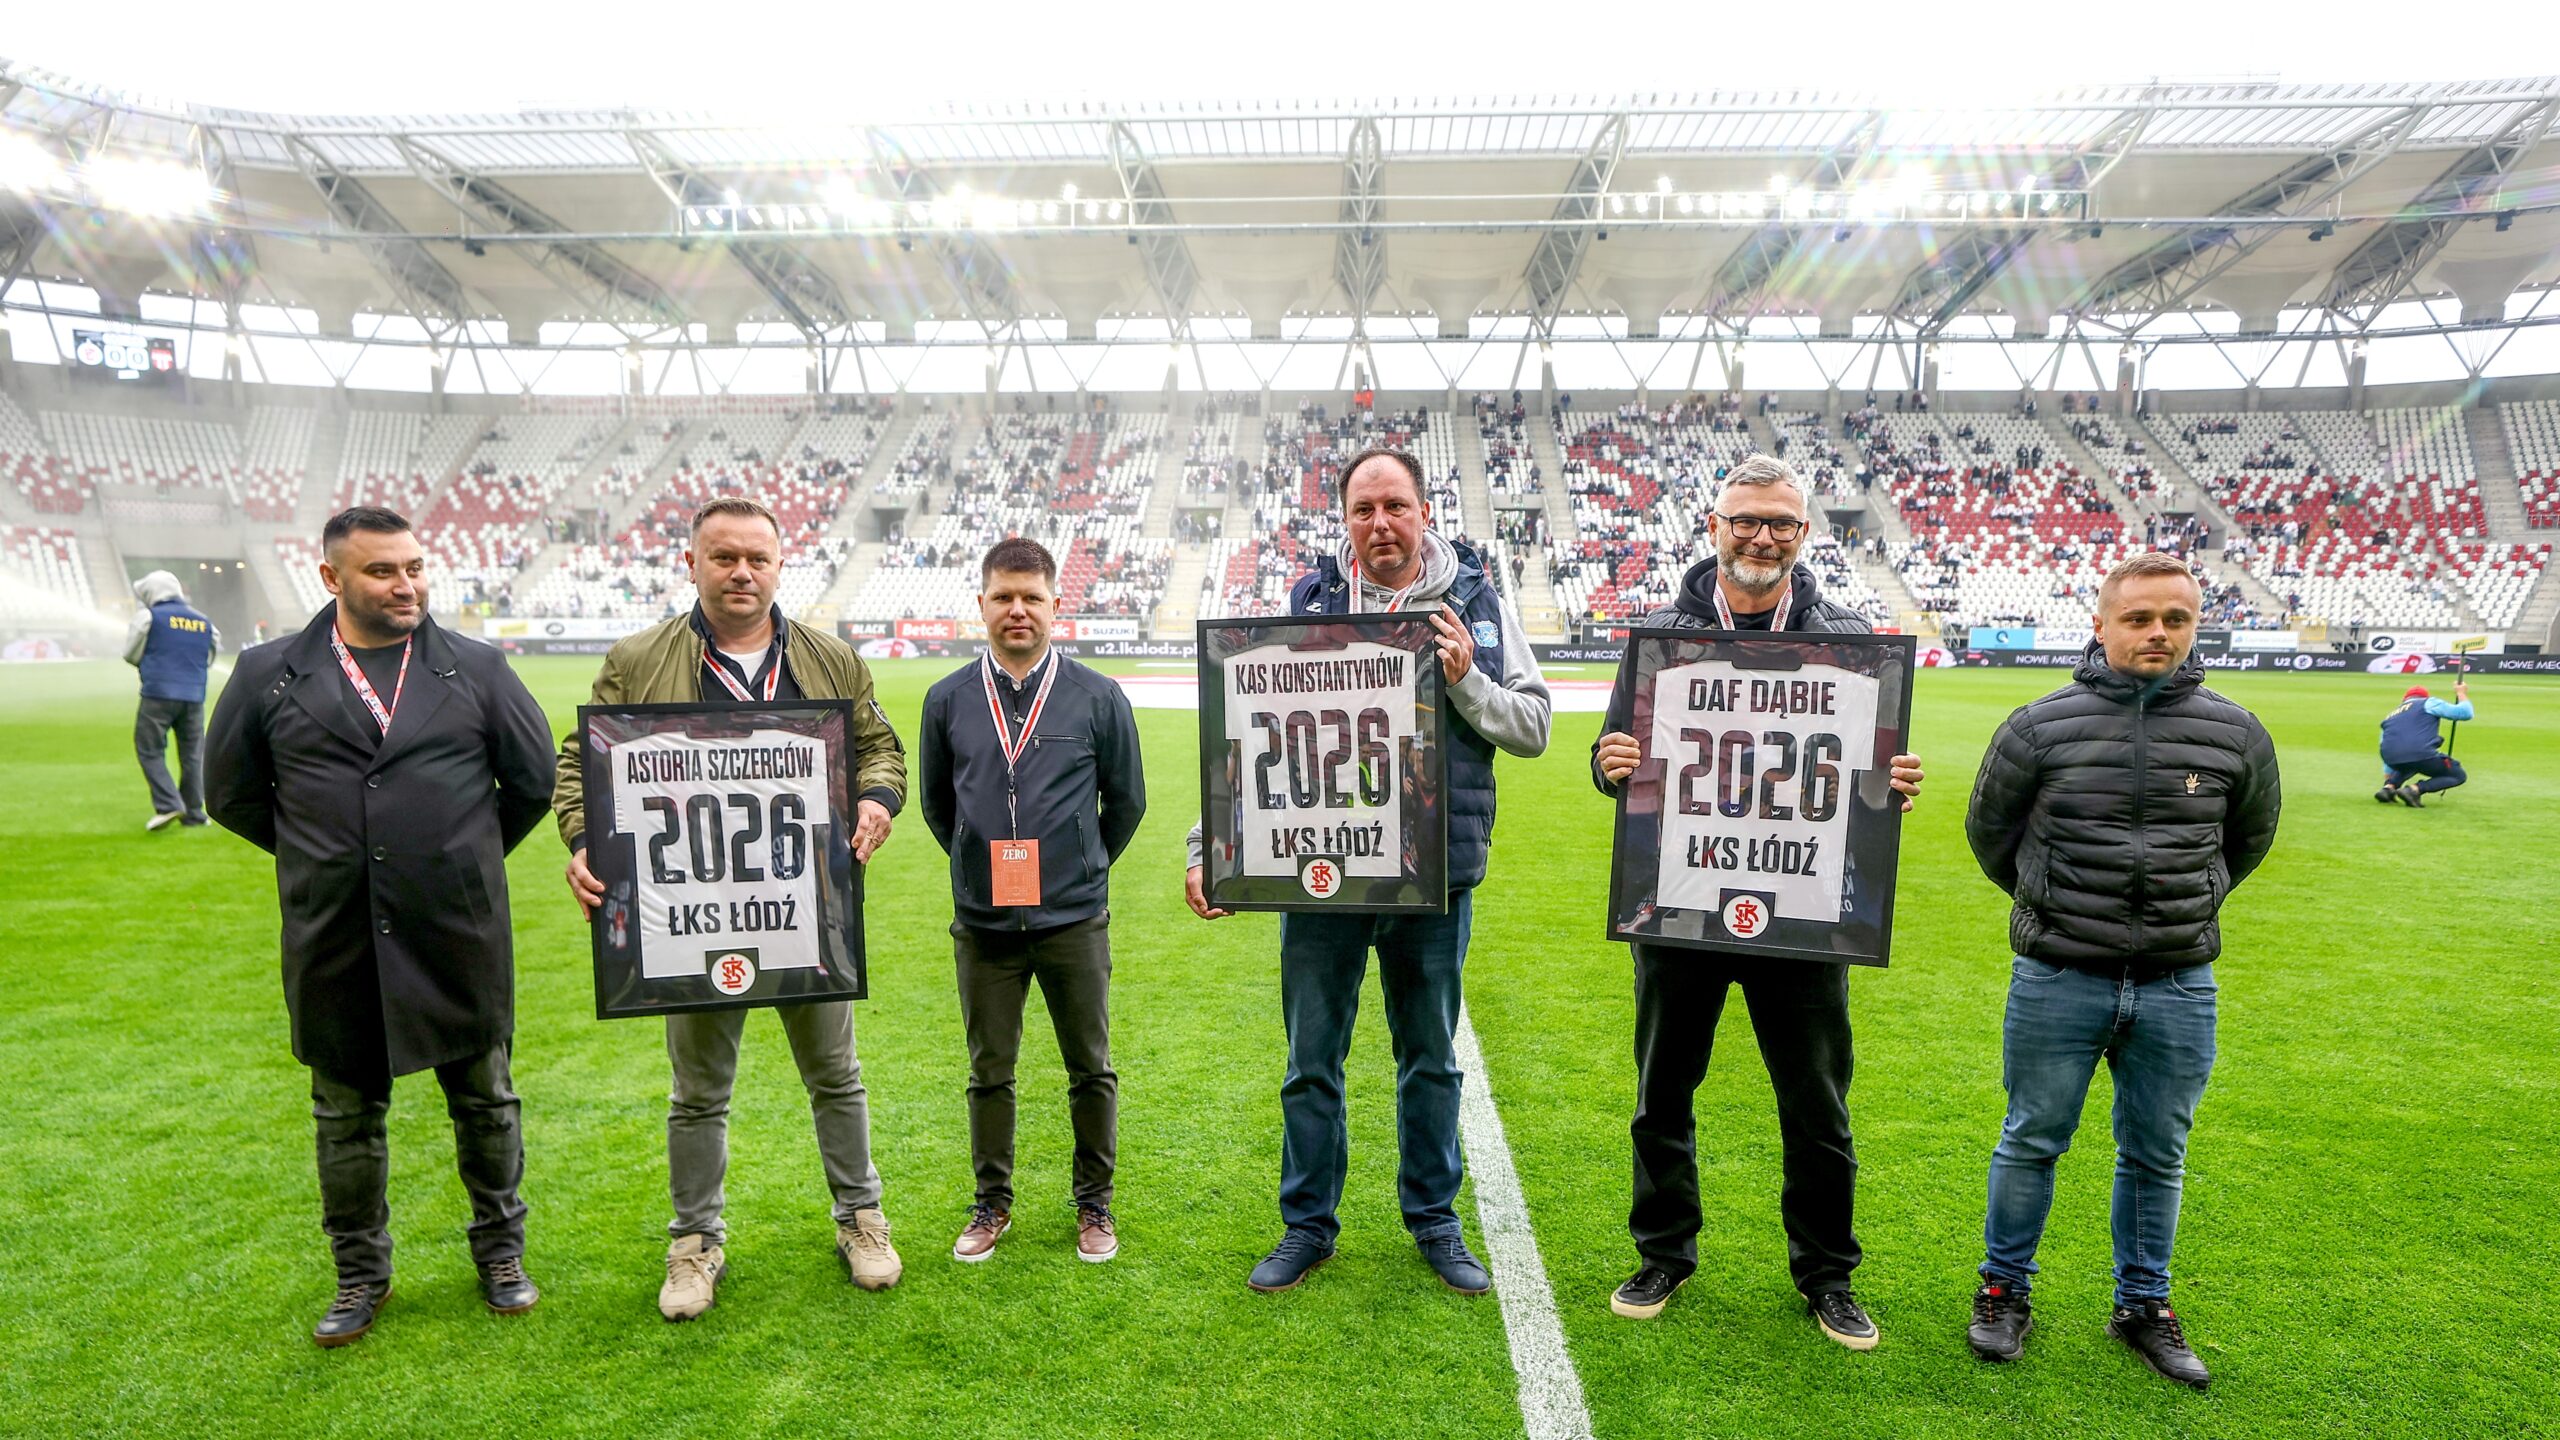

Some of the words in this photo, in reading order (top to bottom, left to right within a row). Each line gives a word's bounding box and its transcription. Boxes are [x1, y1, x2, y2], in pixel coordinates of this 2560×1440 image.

[169, 615, 206, 633] STAFF
[851, 623, 886, 634] BLACK
[902, 623, 949, 637] Betclic
[1095, 642, 1197, 657] u2.lkslodz.pl
[1550, 650, 1582, 659] NOWE
[2015, 655, 2049, 665] NOWE
[2273, 656, 2291, 667] U2
[2315, 657, 2346, 668] Store
[1235, 663, 1267, 694] KAS
[1272, 652, 1403, 694] KONSTANTYNÓW
[2498, 660, 2534, 669] NOWE
[1688, 678, 1742, 712] DAF
[1750, 680, 1836, 719] DĄBIE
[627, 748, 703, 784] ASTORIA
[708, 741, 814, 781] SZCZERCÓW
[1251, 707, 1391, 809] 2026
[1679, 727, 1842, 822] 2026
[642, 792, 806, 884] 2026
[1272, 827, 1317, 859] ŁKS
[1324, 820, 1385, 858] ŁÓDŹ
[1002, 848, 1028, 860] ZERO
[1686, 835, 1740, 870] ŁKS
[1747, 834, 1819, 877] ŁÓDŹ
[668, 903, 721, 936] ŁKS
[730, 894, 798, 932] ŁÓDŹ
